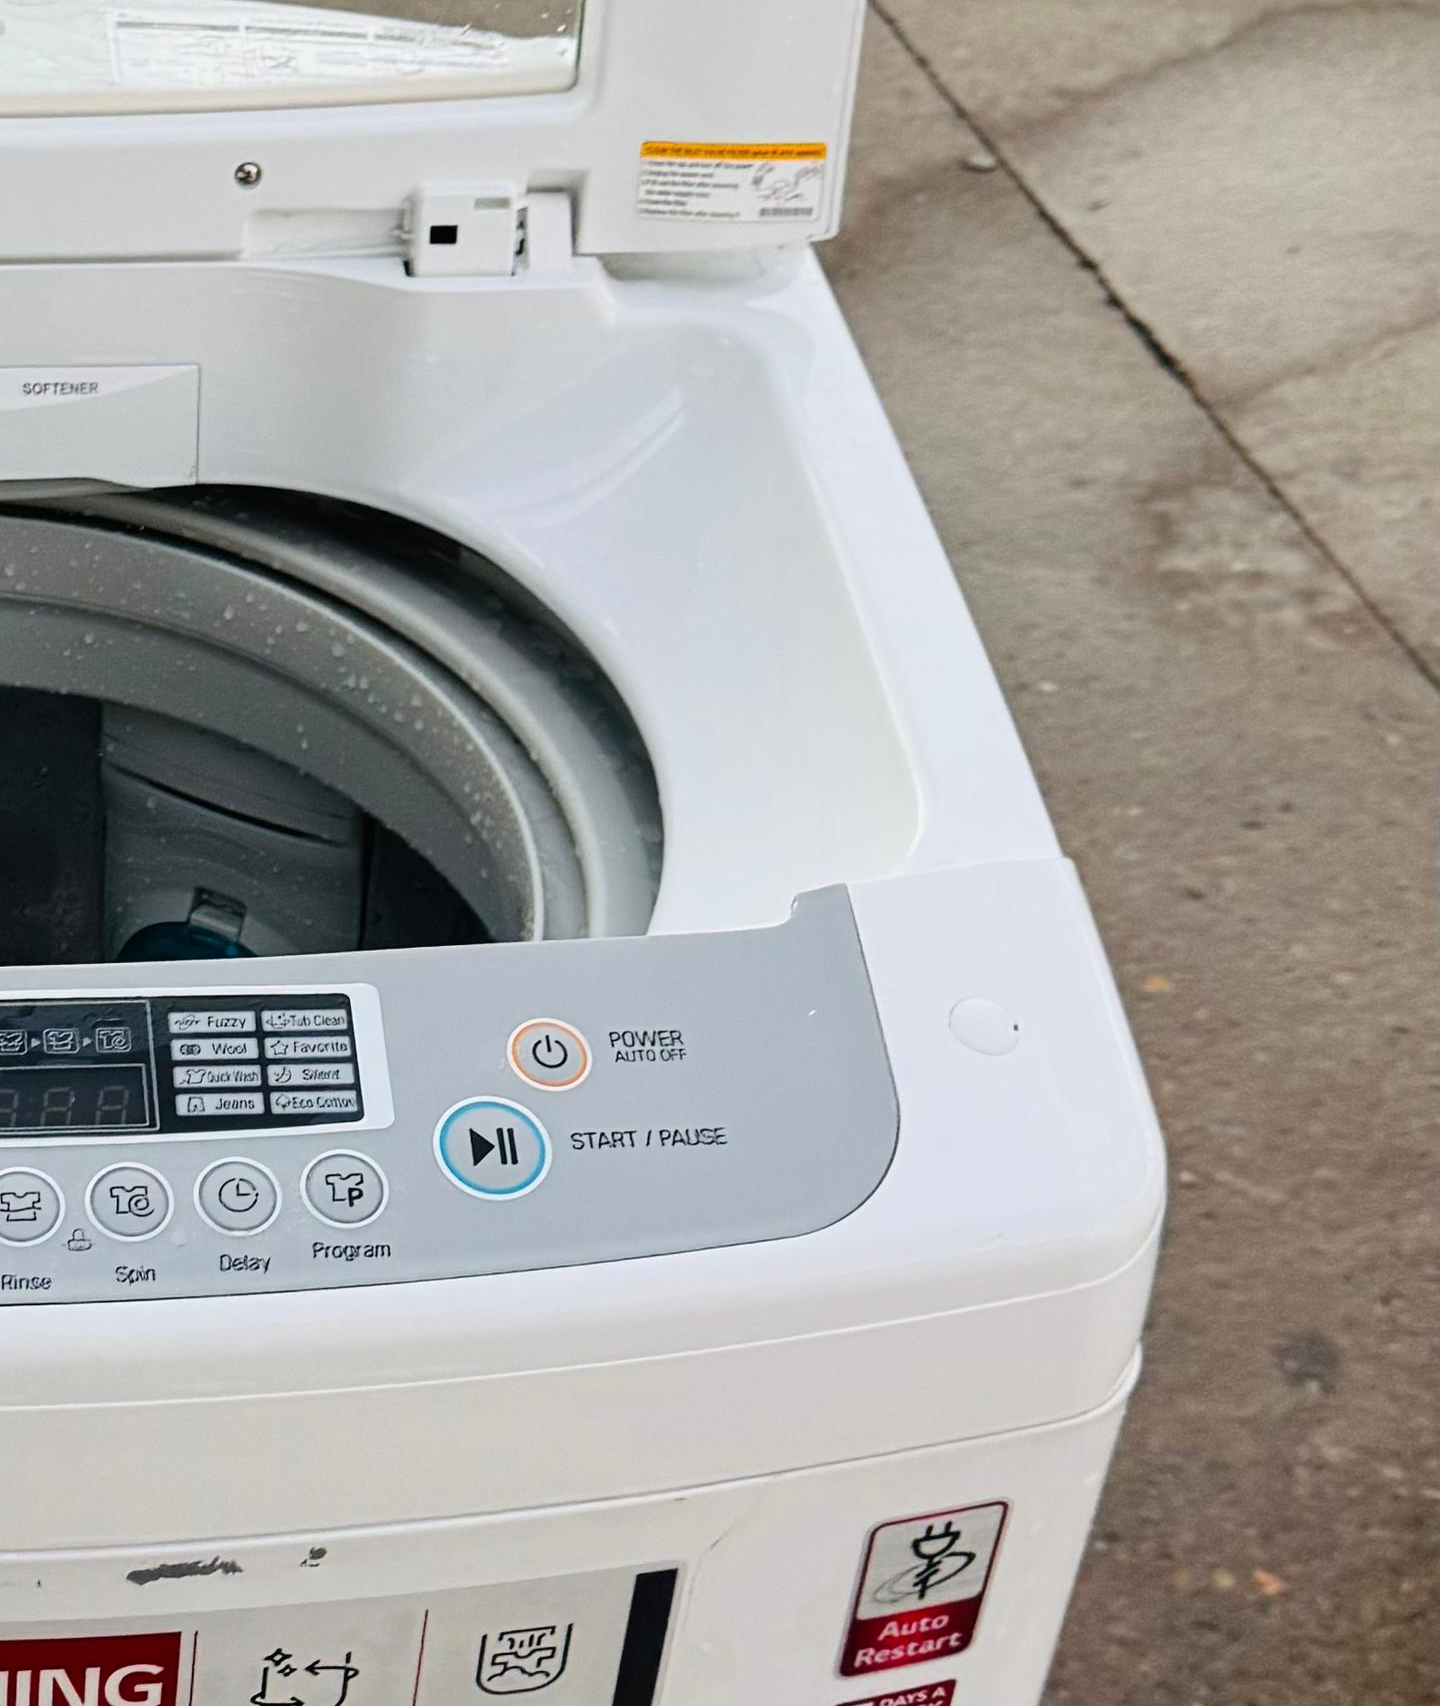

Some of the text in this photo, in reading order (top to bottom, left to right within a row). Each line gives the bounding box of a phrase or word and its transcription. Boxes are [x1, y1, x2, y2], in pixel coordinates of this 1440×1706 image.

[21, 381, 99, 395] SOFTENER
[207, 1016, 246, 1029] Fuzzy
[290, 1015, 346, 1027] Tub Clean
[609, 1030, 684, 1048] POWER
[212, 1043, 247, 1055] Wool
[293, 1041, 348, 1053] Favorite
[615, 1048, 687, 1063] AUTO OFF
[215, 1097, 255, 1110] Jeans
[291, 1097, 314, 1109] Eco
[570, 1130, 638, 1150] START
[659, 1127, 728, 1147] PAUSE
[312, 1241, 392, 1262] Program
[219, 1253, 272, 1274] Delay
[1, 1274, 53, 1290] Rinse
[115, 1265, 157, 1286] Spin
[877, 1615, 950, 1641] Auto
[854, 1632, 962, 1668] Restart
[931, 1687, 946, 1698] A
